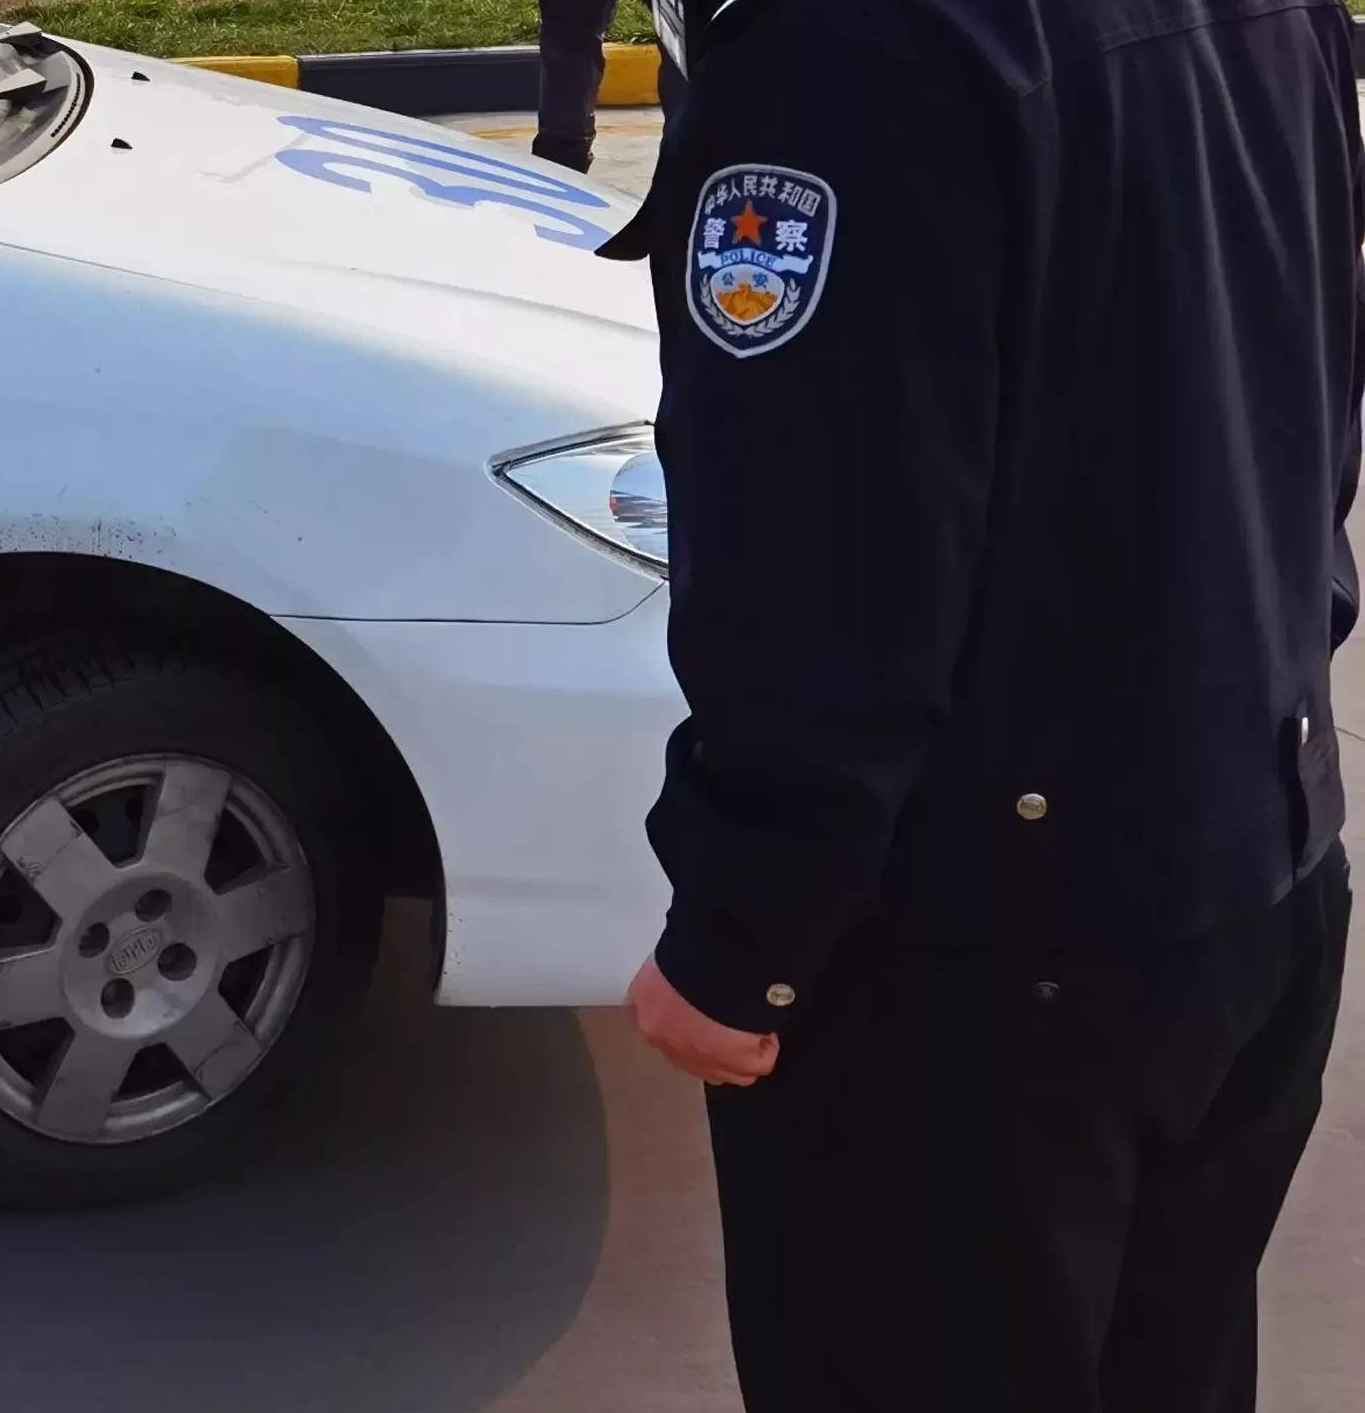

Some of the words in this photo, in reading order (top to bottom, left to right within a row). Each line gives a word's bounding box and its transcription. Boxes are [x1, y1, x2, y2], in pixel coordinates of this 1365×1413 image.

[704, 175, 822, 217] 中华人民共和国
[720, 249, 777, 269] POLICE
